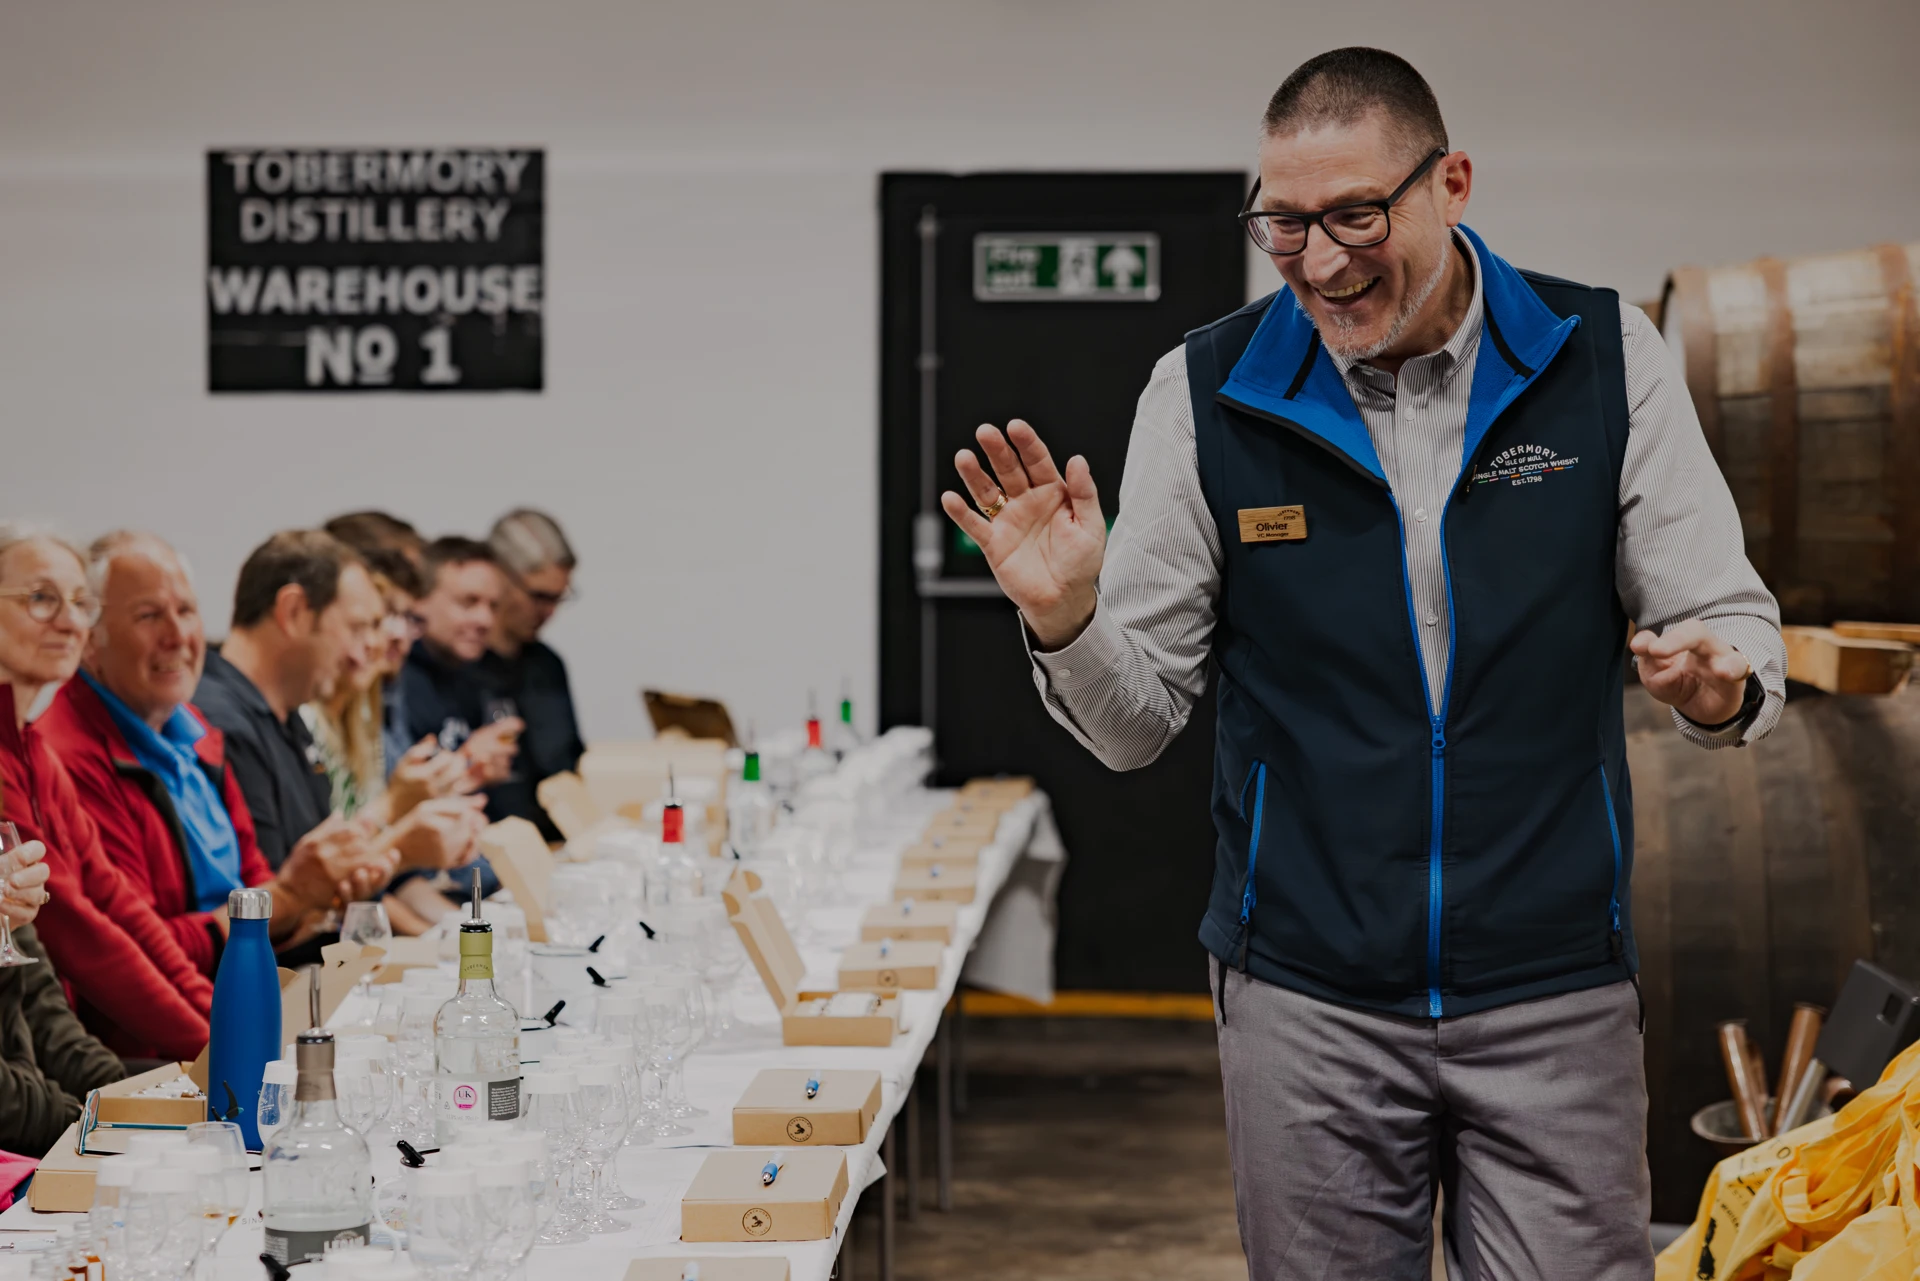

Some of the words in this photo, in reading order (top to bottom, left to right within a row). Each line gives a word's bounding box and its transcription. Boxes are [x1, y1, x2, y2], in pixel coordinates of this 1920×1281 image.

[226, 151, 527, 194] TOBERMORY
[241, 200, 510, 243] DISTILLERY
[209, 266, 542, 315] WAREHOUSE
[419, 328, 462, 385] 1
[1490, 444, 1557, 469] TOBERMORY
[1498, 467, 1517, 476] MALT
[1518, 462, 1549, 473] SCOTCH
[1550, 457, 1579, 468] WHISKY
[1256, 521, 1288, 532] Olivier
[458, 1090, 472, 1099] UK
